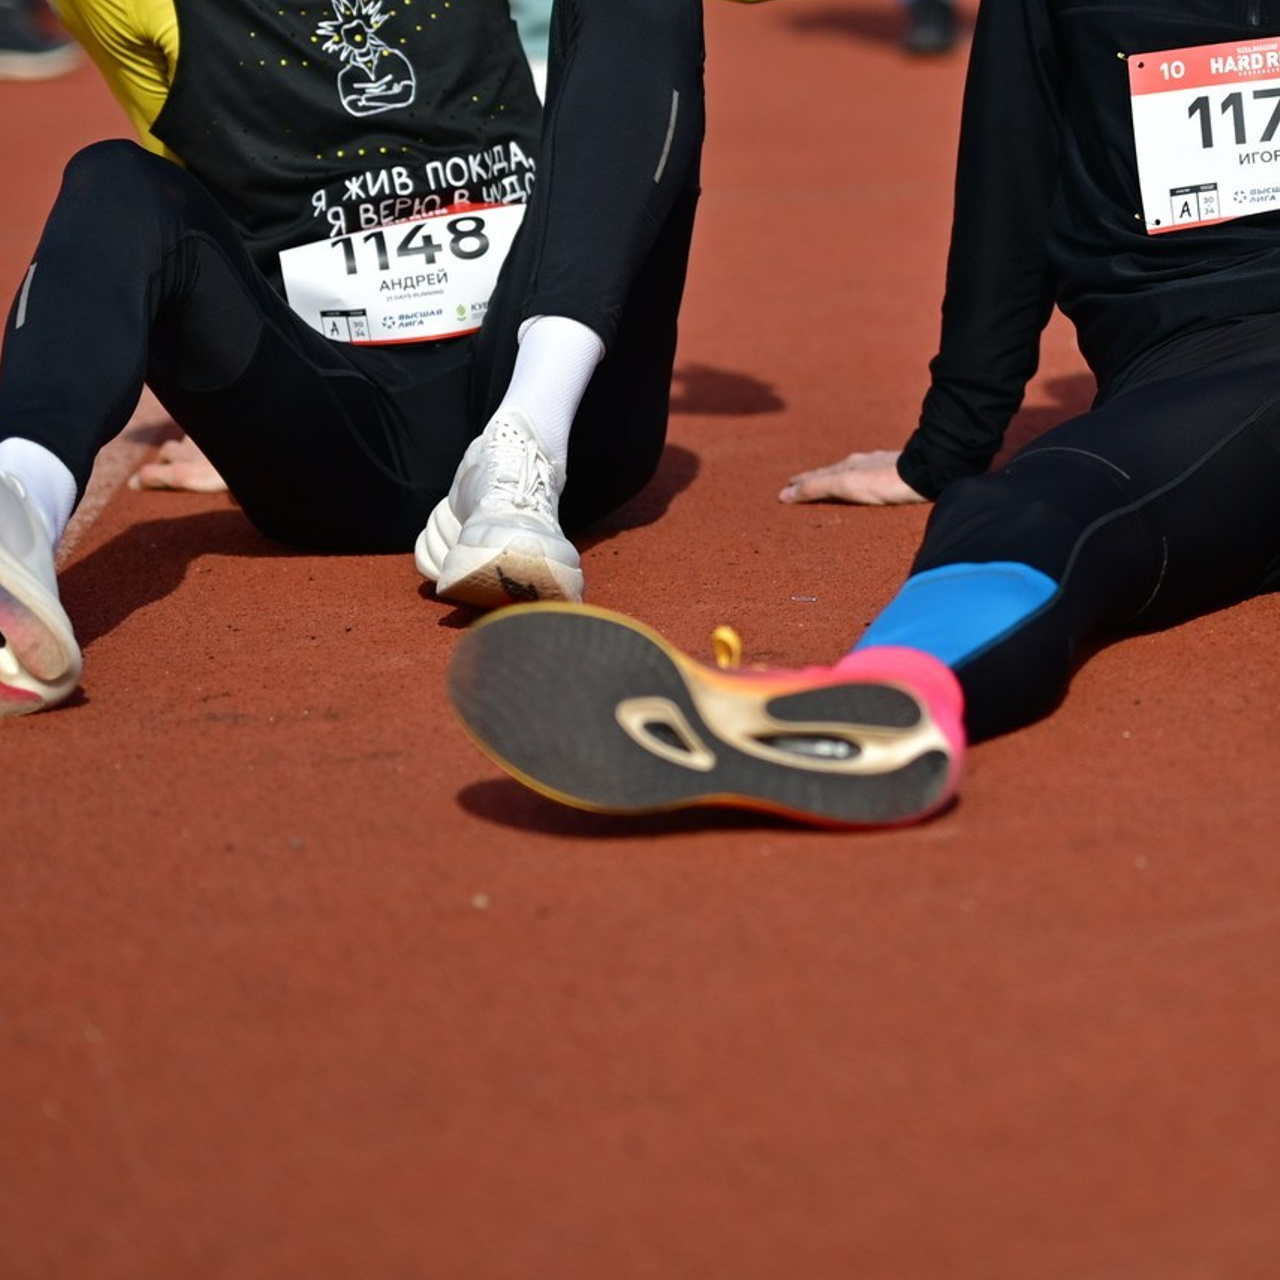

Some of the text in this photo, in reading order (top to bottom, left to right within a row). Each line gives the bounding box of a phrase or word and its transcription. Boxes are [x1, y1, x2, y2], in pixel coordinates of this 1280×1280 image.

[1160, 60, 1185, 81] 10
[1210, 52, 1265, 74] HARD
[311, 140, 536, 217] Я ЖИВ ПОКУДА,
[1249, 194, 1276, 203] ЛИГА
[327, 206, 347, 237] Я
[359, 194, 441, 229] ВЕРЮ
[331, 216, 489, 275] 1148
[379, 269, 449, 292] АНДРЕЙ
[398, 309, 443, 321] ВЫСШАЯ
[398, 320, 424, 328] ЛИГА
